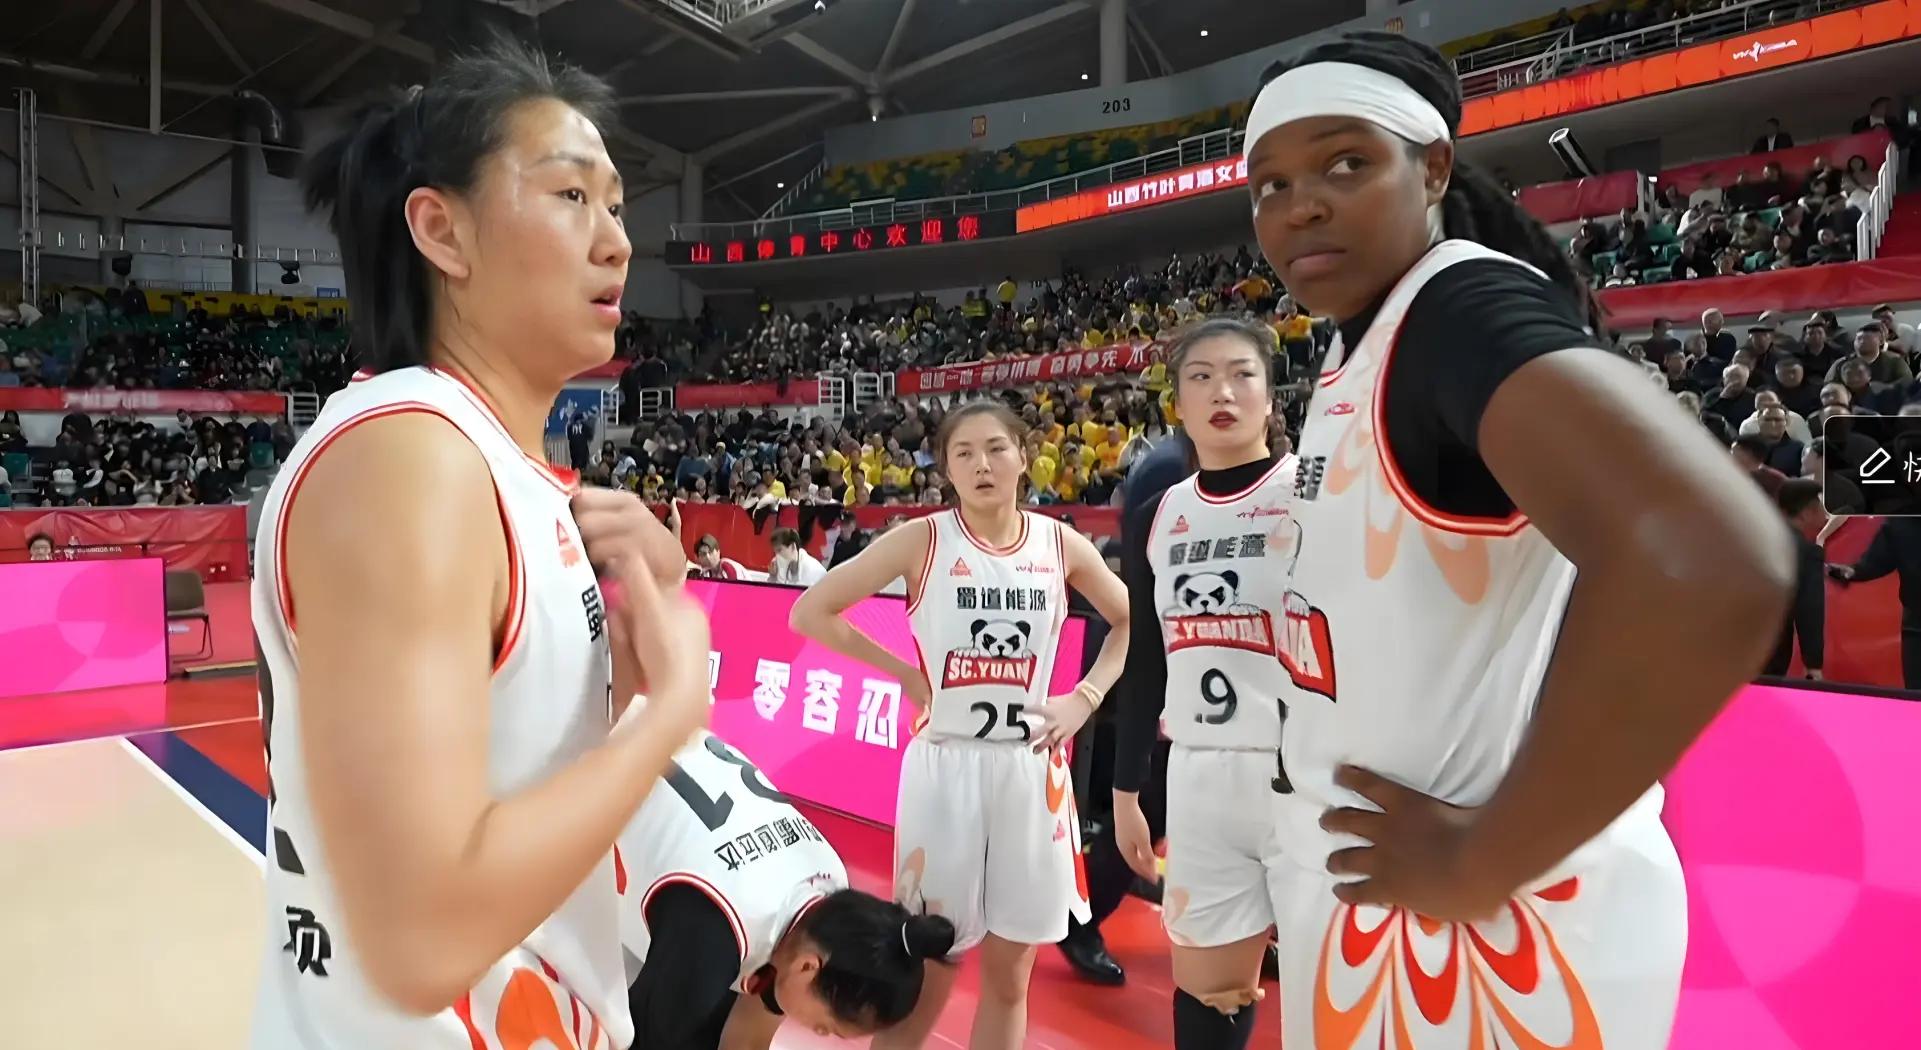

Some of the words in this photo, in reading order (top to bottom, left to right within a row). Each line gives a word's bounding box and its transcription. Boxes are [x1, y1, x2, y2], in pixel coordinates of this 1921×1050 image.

[1102, 97, 1131, 114] 203
[1194, 667, 1238, 725] 9
[970, 701, 1031, 741] 25
